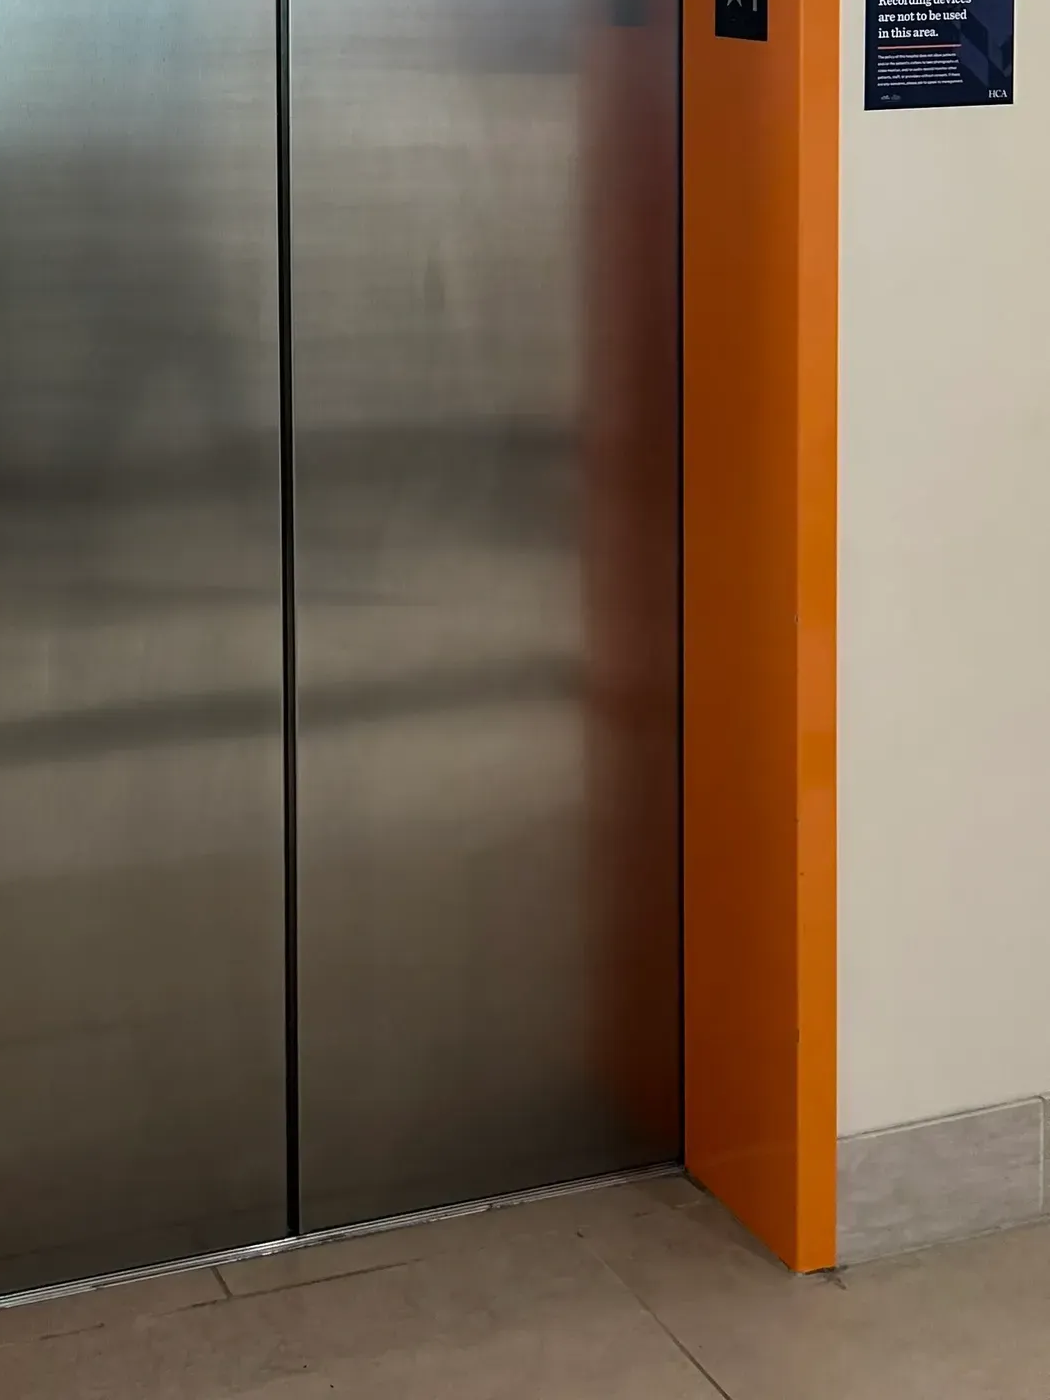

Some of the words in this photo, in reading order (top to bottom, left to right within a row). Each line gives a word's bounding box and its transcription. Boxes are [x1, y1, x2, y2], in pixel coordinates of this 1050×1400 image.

[878, 13, 896, 22] are
[897, 11, 915, 22] not
[916, 11, 927, 21] to
[929, 10, 941, 21] be
[943, 9, 967, 20] used
[878, 28, 889, 39] in
[890, 27, 912, 38] this
[913, 29, 939, 38] area.
[988, 89, 1008, 99] HCA
